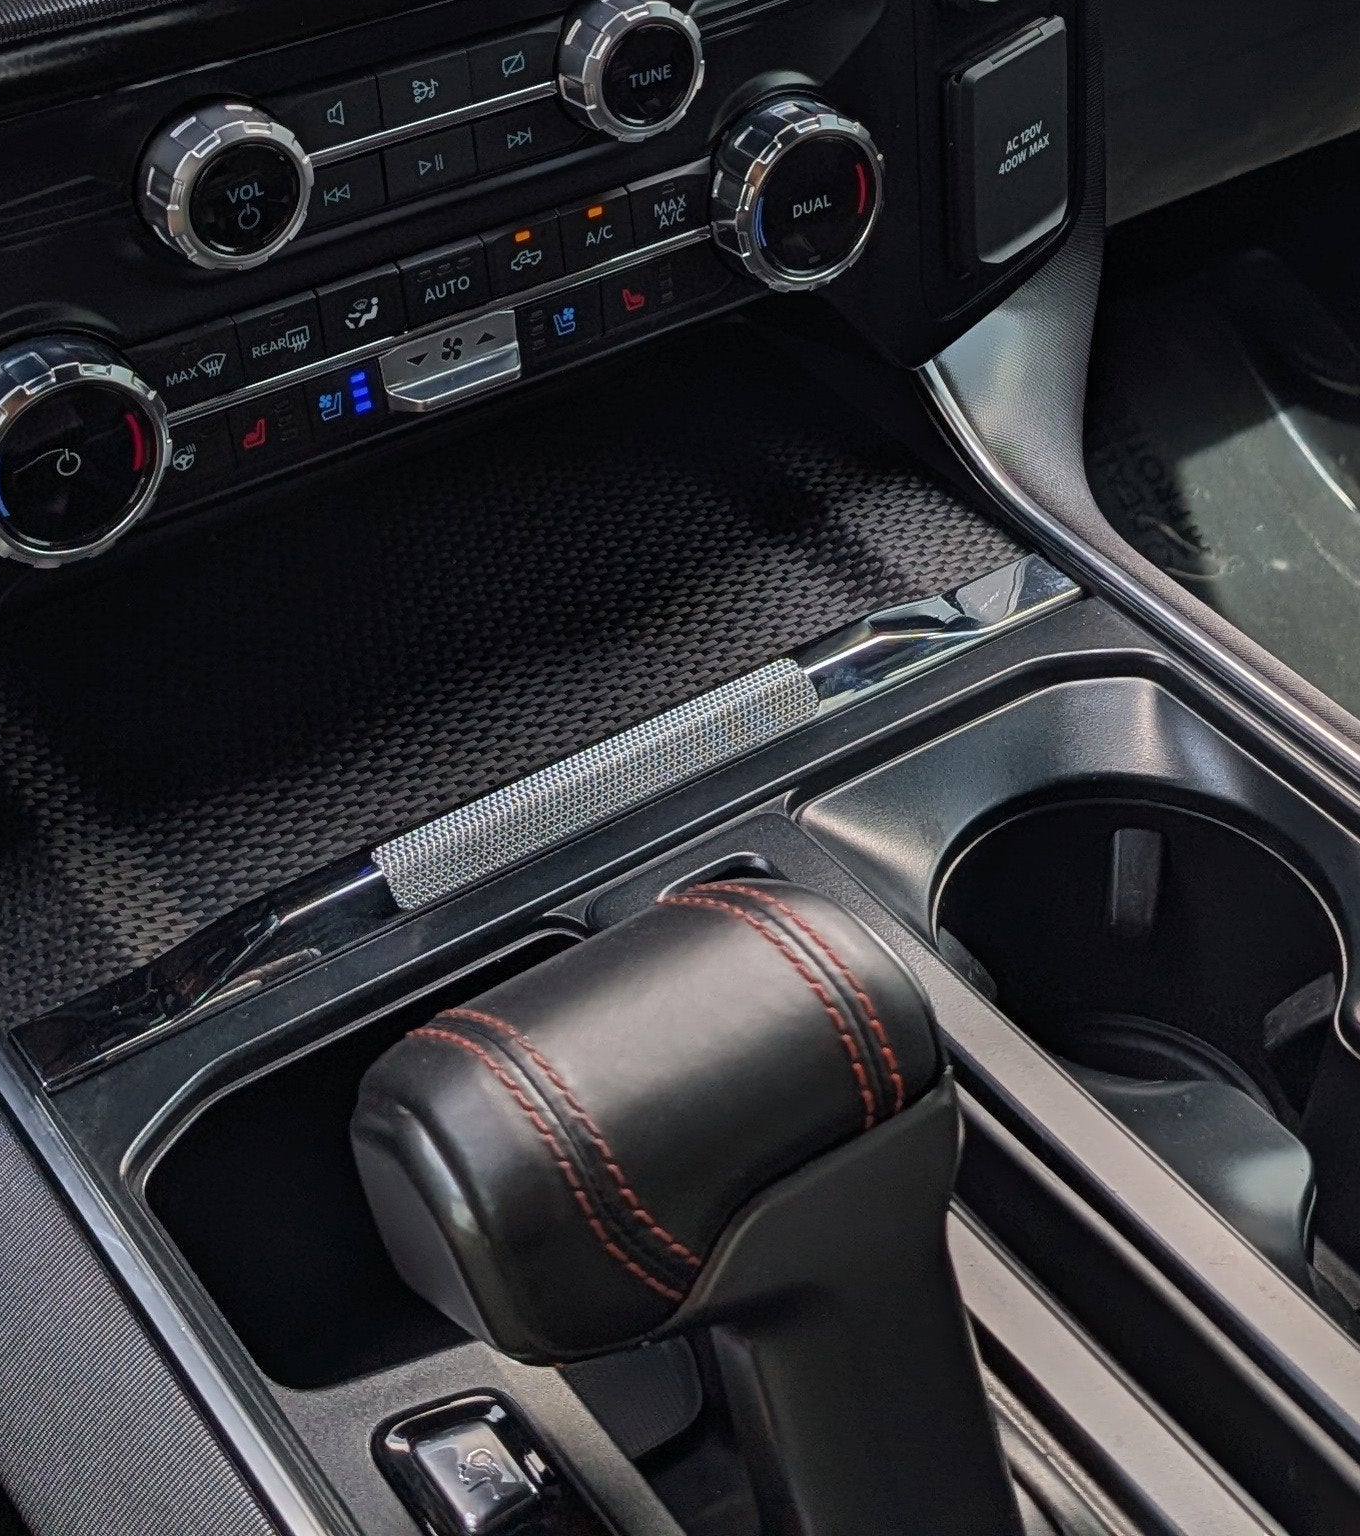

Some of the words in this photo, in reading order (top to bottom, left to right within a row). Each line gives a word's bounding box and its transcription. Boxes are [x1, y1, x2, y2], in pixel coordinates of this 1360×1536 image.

[629, 63, 672, 88] TUNE
[1005, 135, 1020, 155] AC
[1020, 120, 1043, 145] 120V
[998, 148, 1027, 175] 400W
[1029, 133, 1050, 158] MAX
[226, 182, 265, 205] VOL
[653, 194, 687, 218] MAX
[792, 193, 833, 217] DUAL
[659, 207, 686, 229] A/C
[585, 224, 615, 249] A/C
[423, 274, 471, 305] AUTO
[251, 335, 287, 360] REAR
[165, 367, 198, 388] MAX
